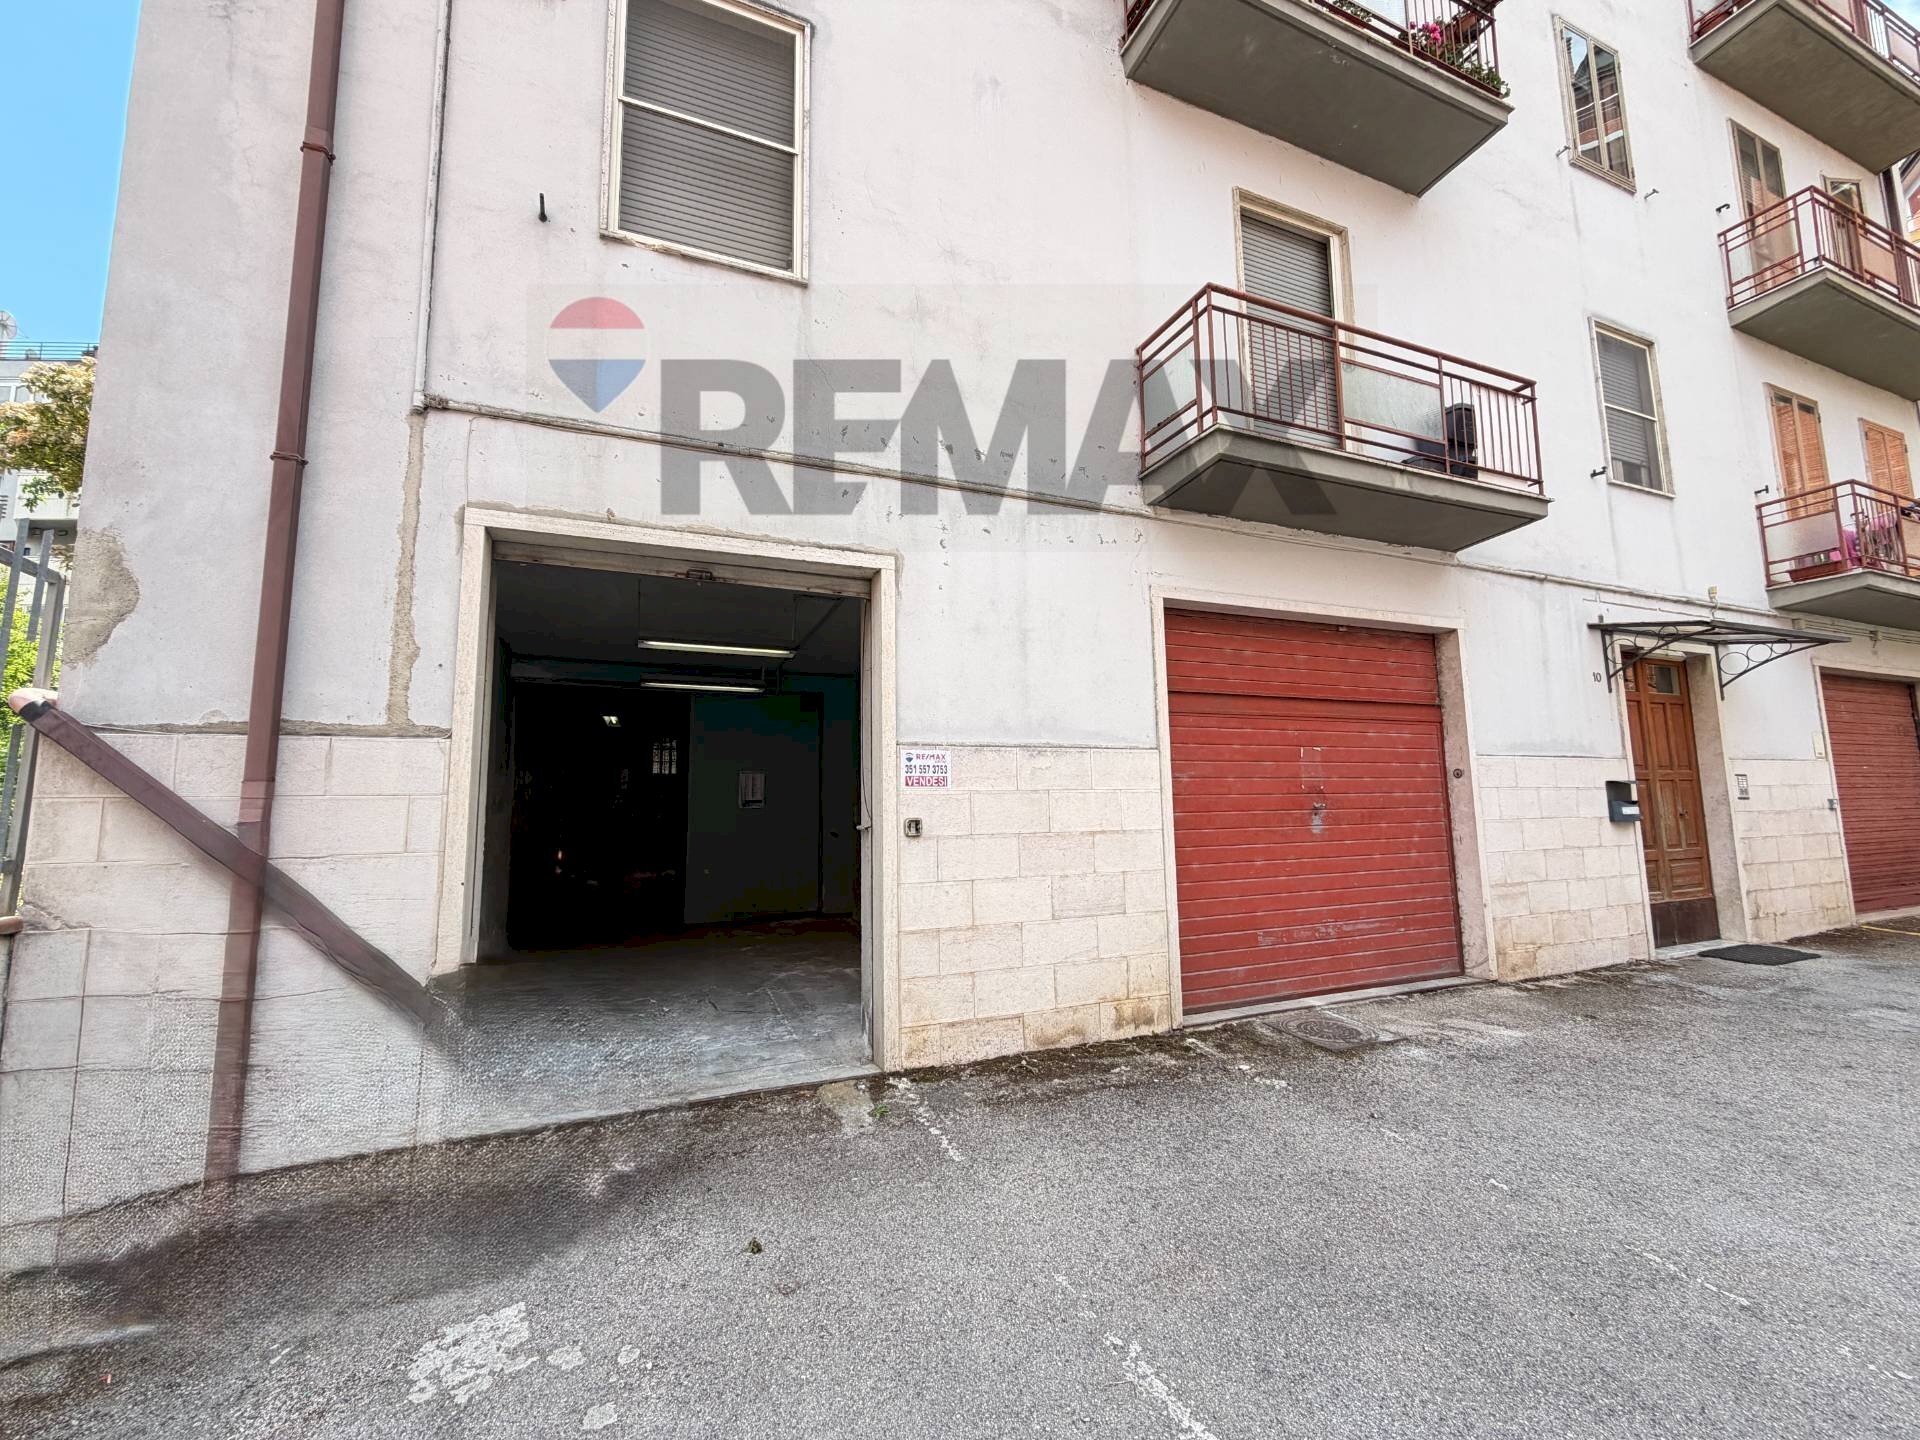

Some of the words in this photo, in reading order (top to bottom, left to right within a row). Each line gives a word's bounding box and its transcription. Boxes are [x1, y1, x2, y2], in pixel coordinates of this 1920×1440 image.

[1592, 671, 1602, 682] 10
[905, 764, 917, 774] 351
[919, 764, 931, 774] 557
[906, 776, 947, 787] VENDESI
